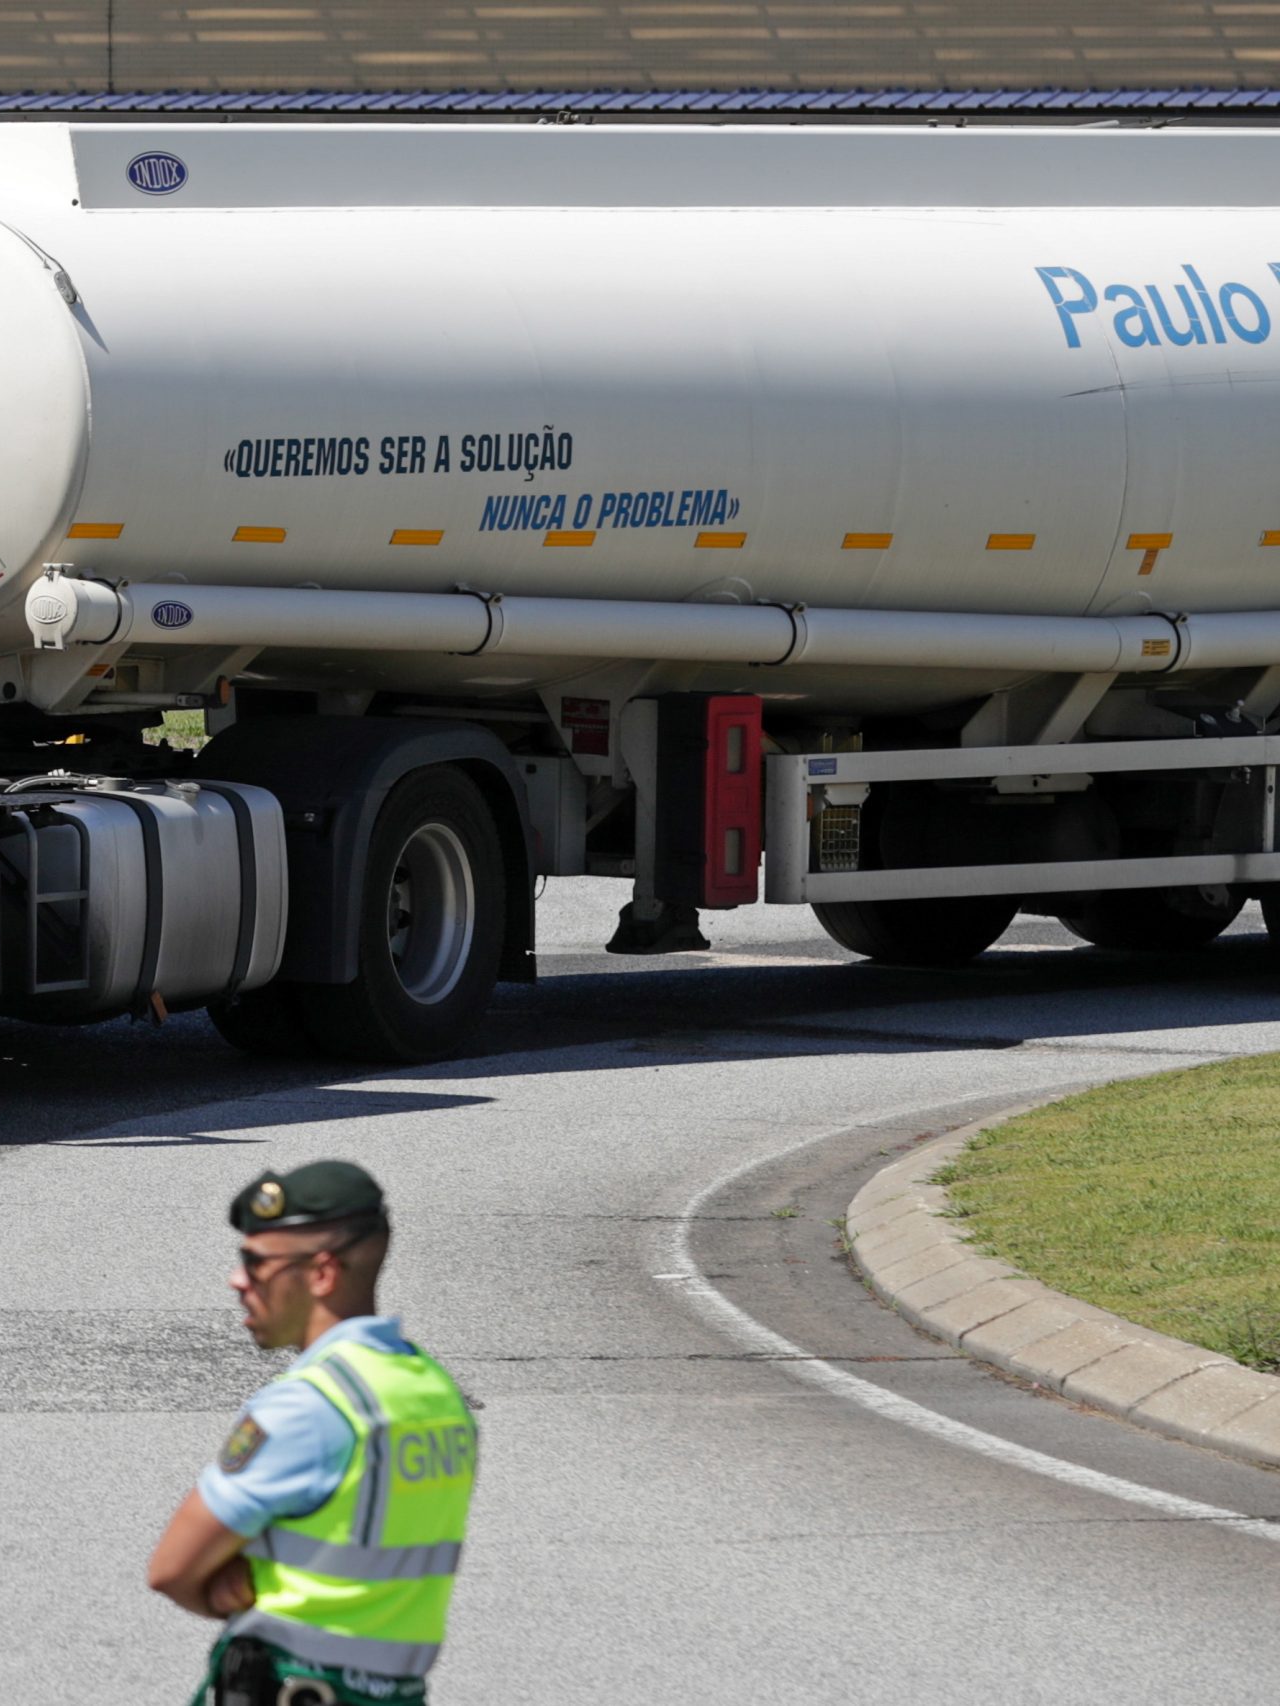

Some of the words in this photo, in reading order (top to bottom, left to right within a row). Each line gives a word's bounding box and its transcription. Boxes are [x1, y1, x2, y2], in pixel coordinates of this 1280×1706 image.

[133, 158, 181, 188] INDOX
[1033, 263, 1271, 348] Paulo
[378, 435, 426, 474] SER
[433, 435, 451, 473] A
[460, 424, 573, 482] SOLUÇÃO
[478, 494, 567, 532] NUNCA
[572, 493, 594, 530] O
[157, 604, 188, 626] INDOX
